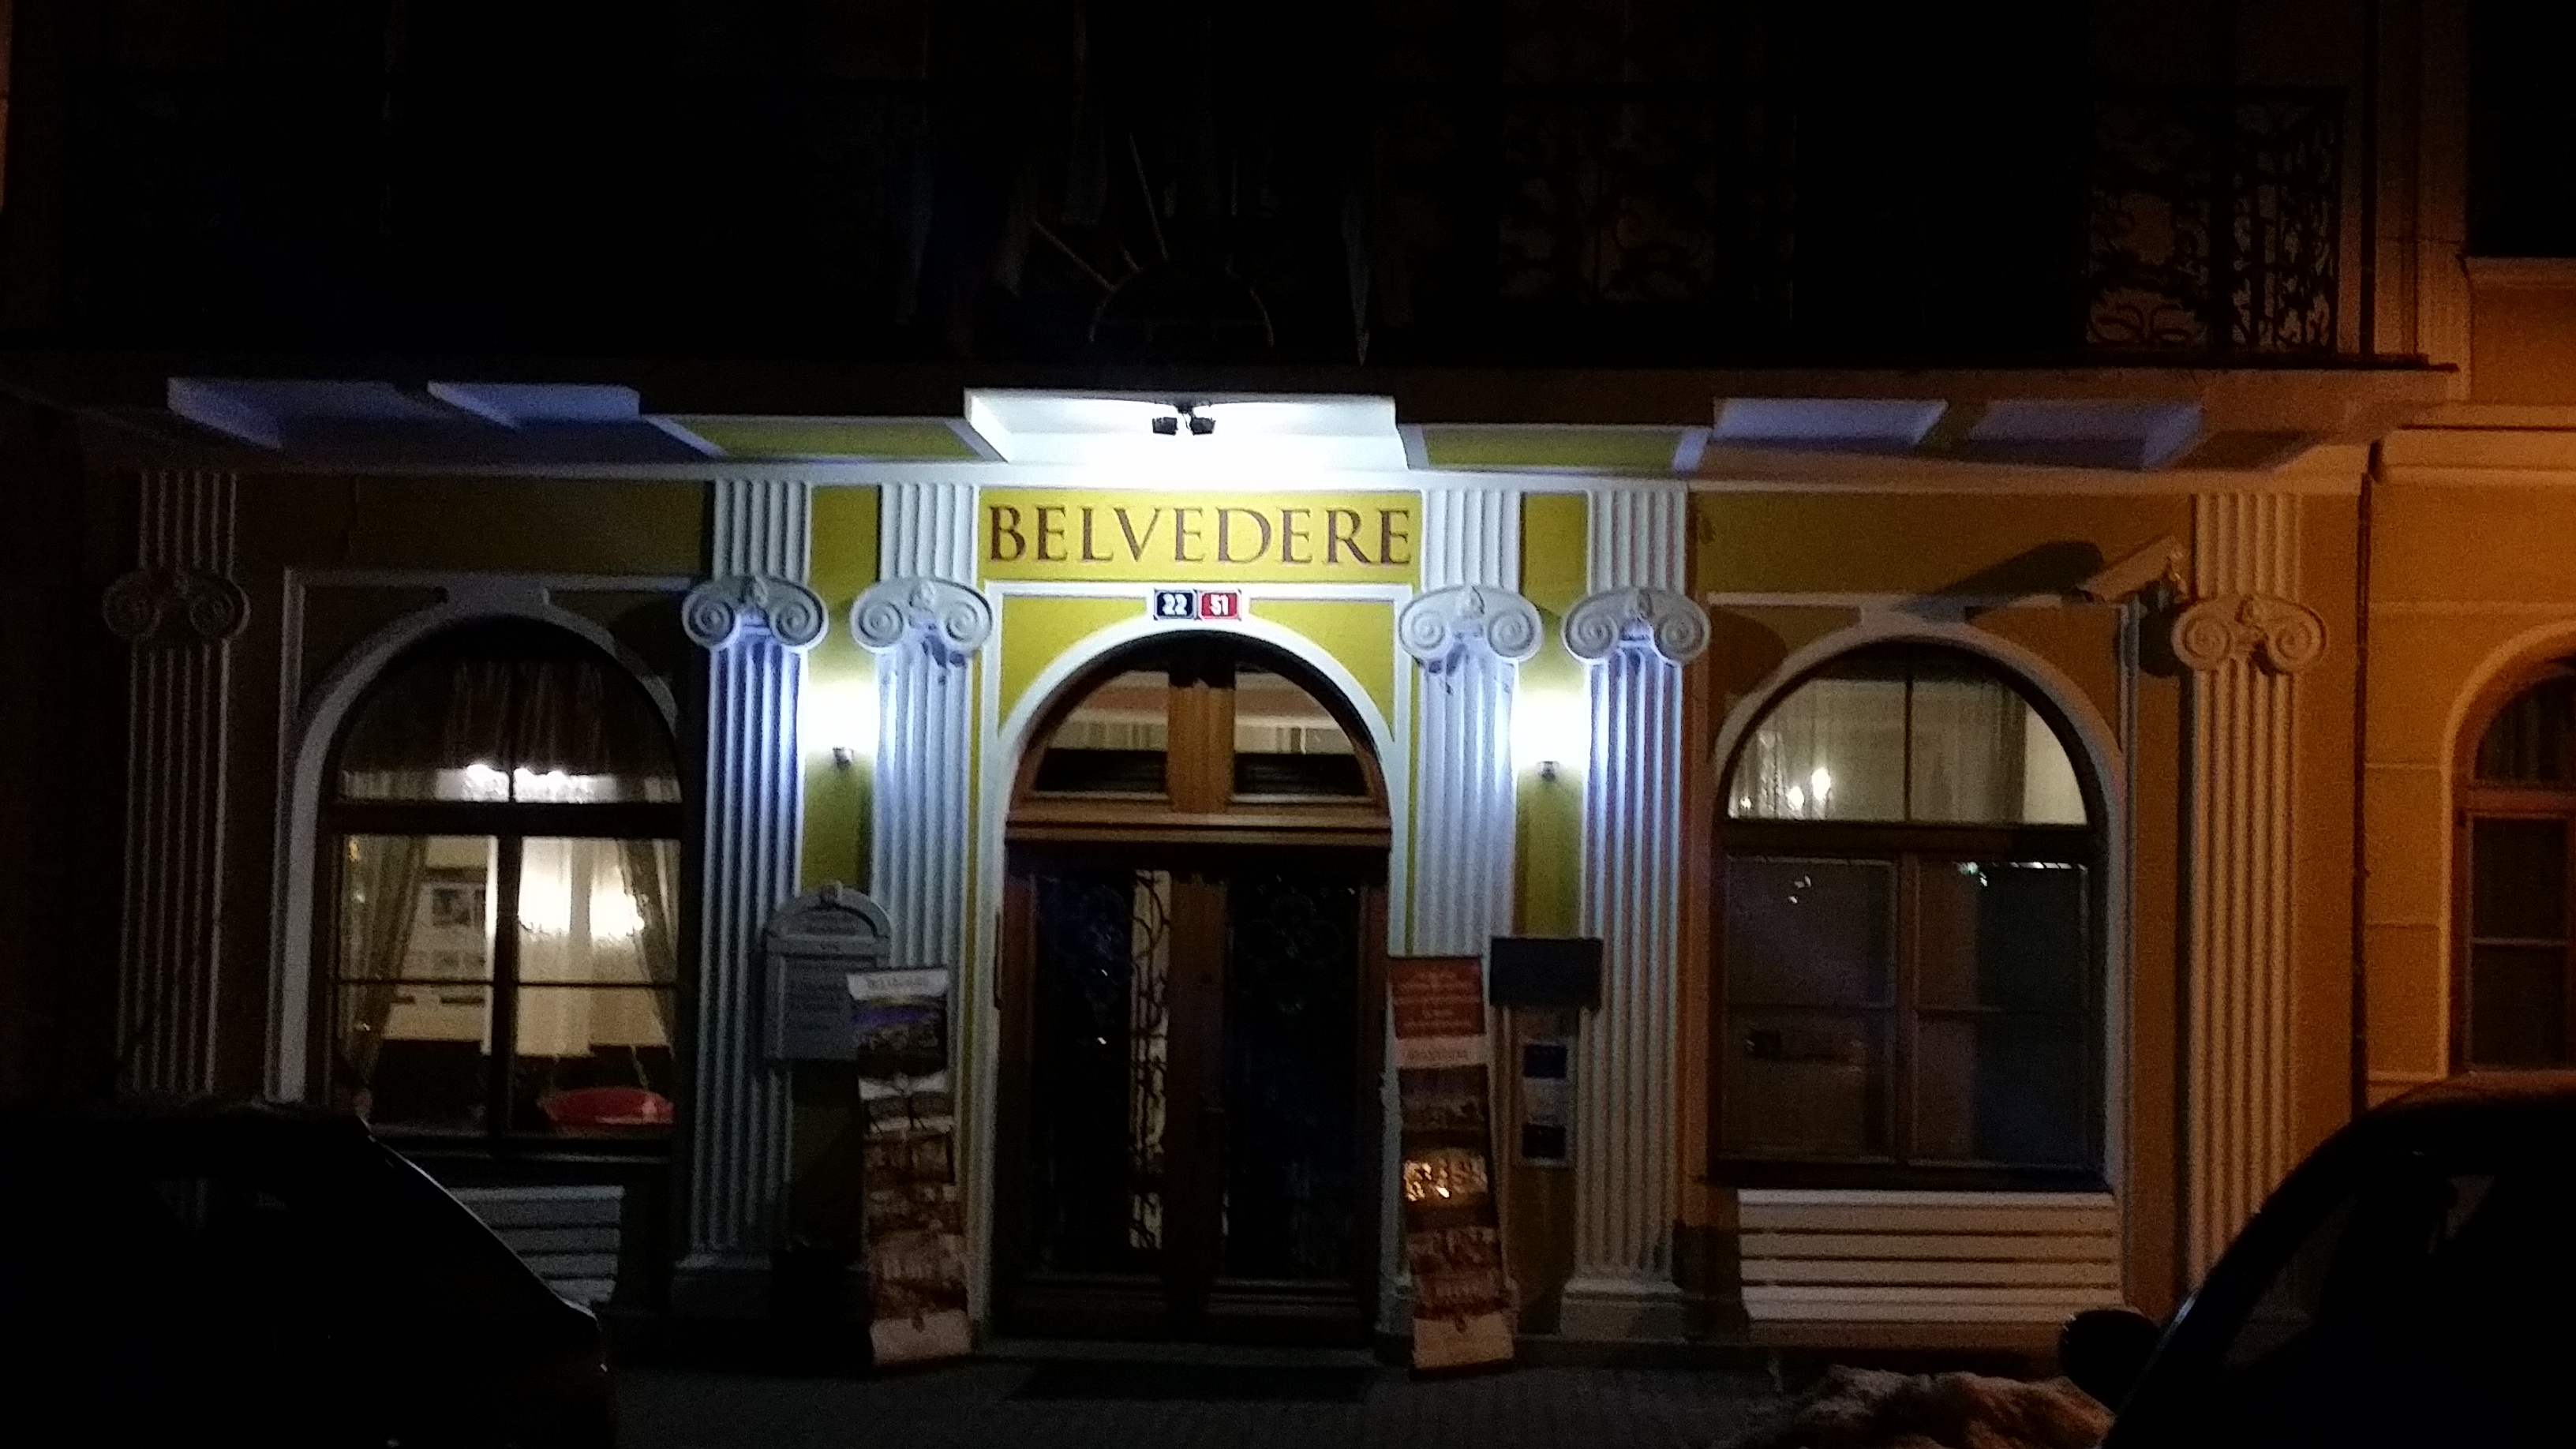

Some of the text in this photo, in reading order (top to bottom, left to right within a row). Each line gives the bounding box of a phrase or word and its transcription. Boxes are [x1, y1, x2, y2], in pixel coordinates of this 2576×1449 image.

[988, 505, 1413, 565] BELVEDERE
[1162, 593, 1188, 616] 22
[1209, 593, 1230, 616] 51
